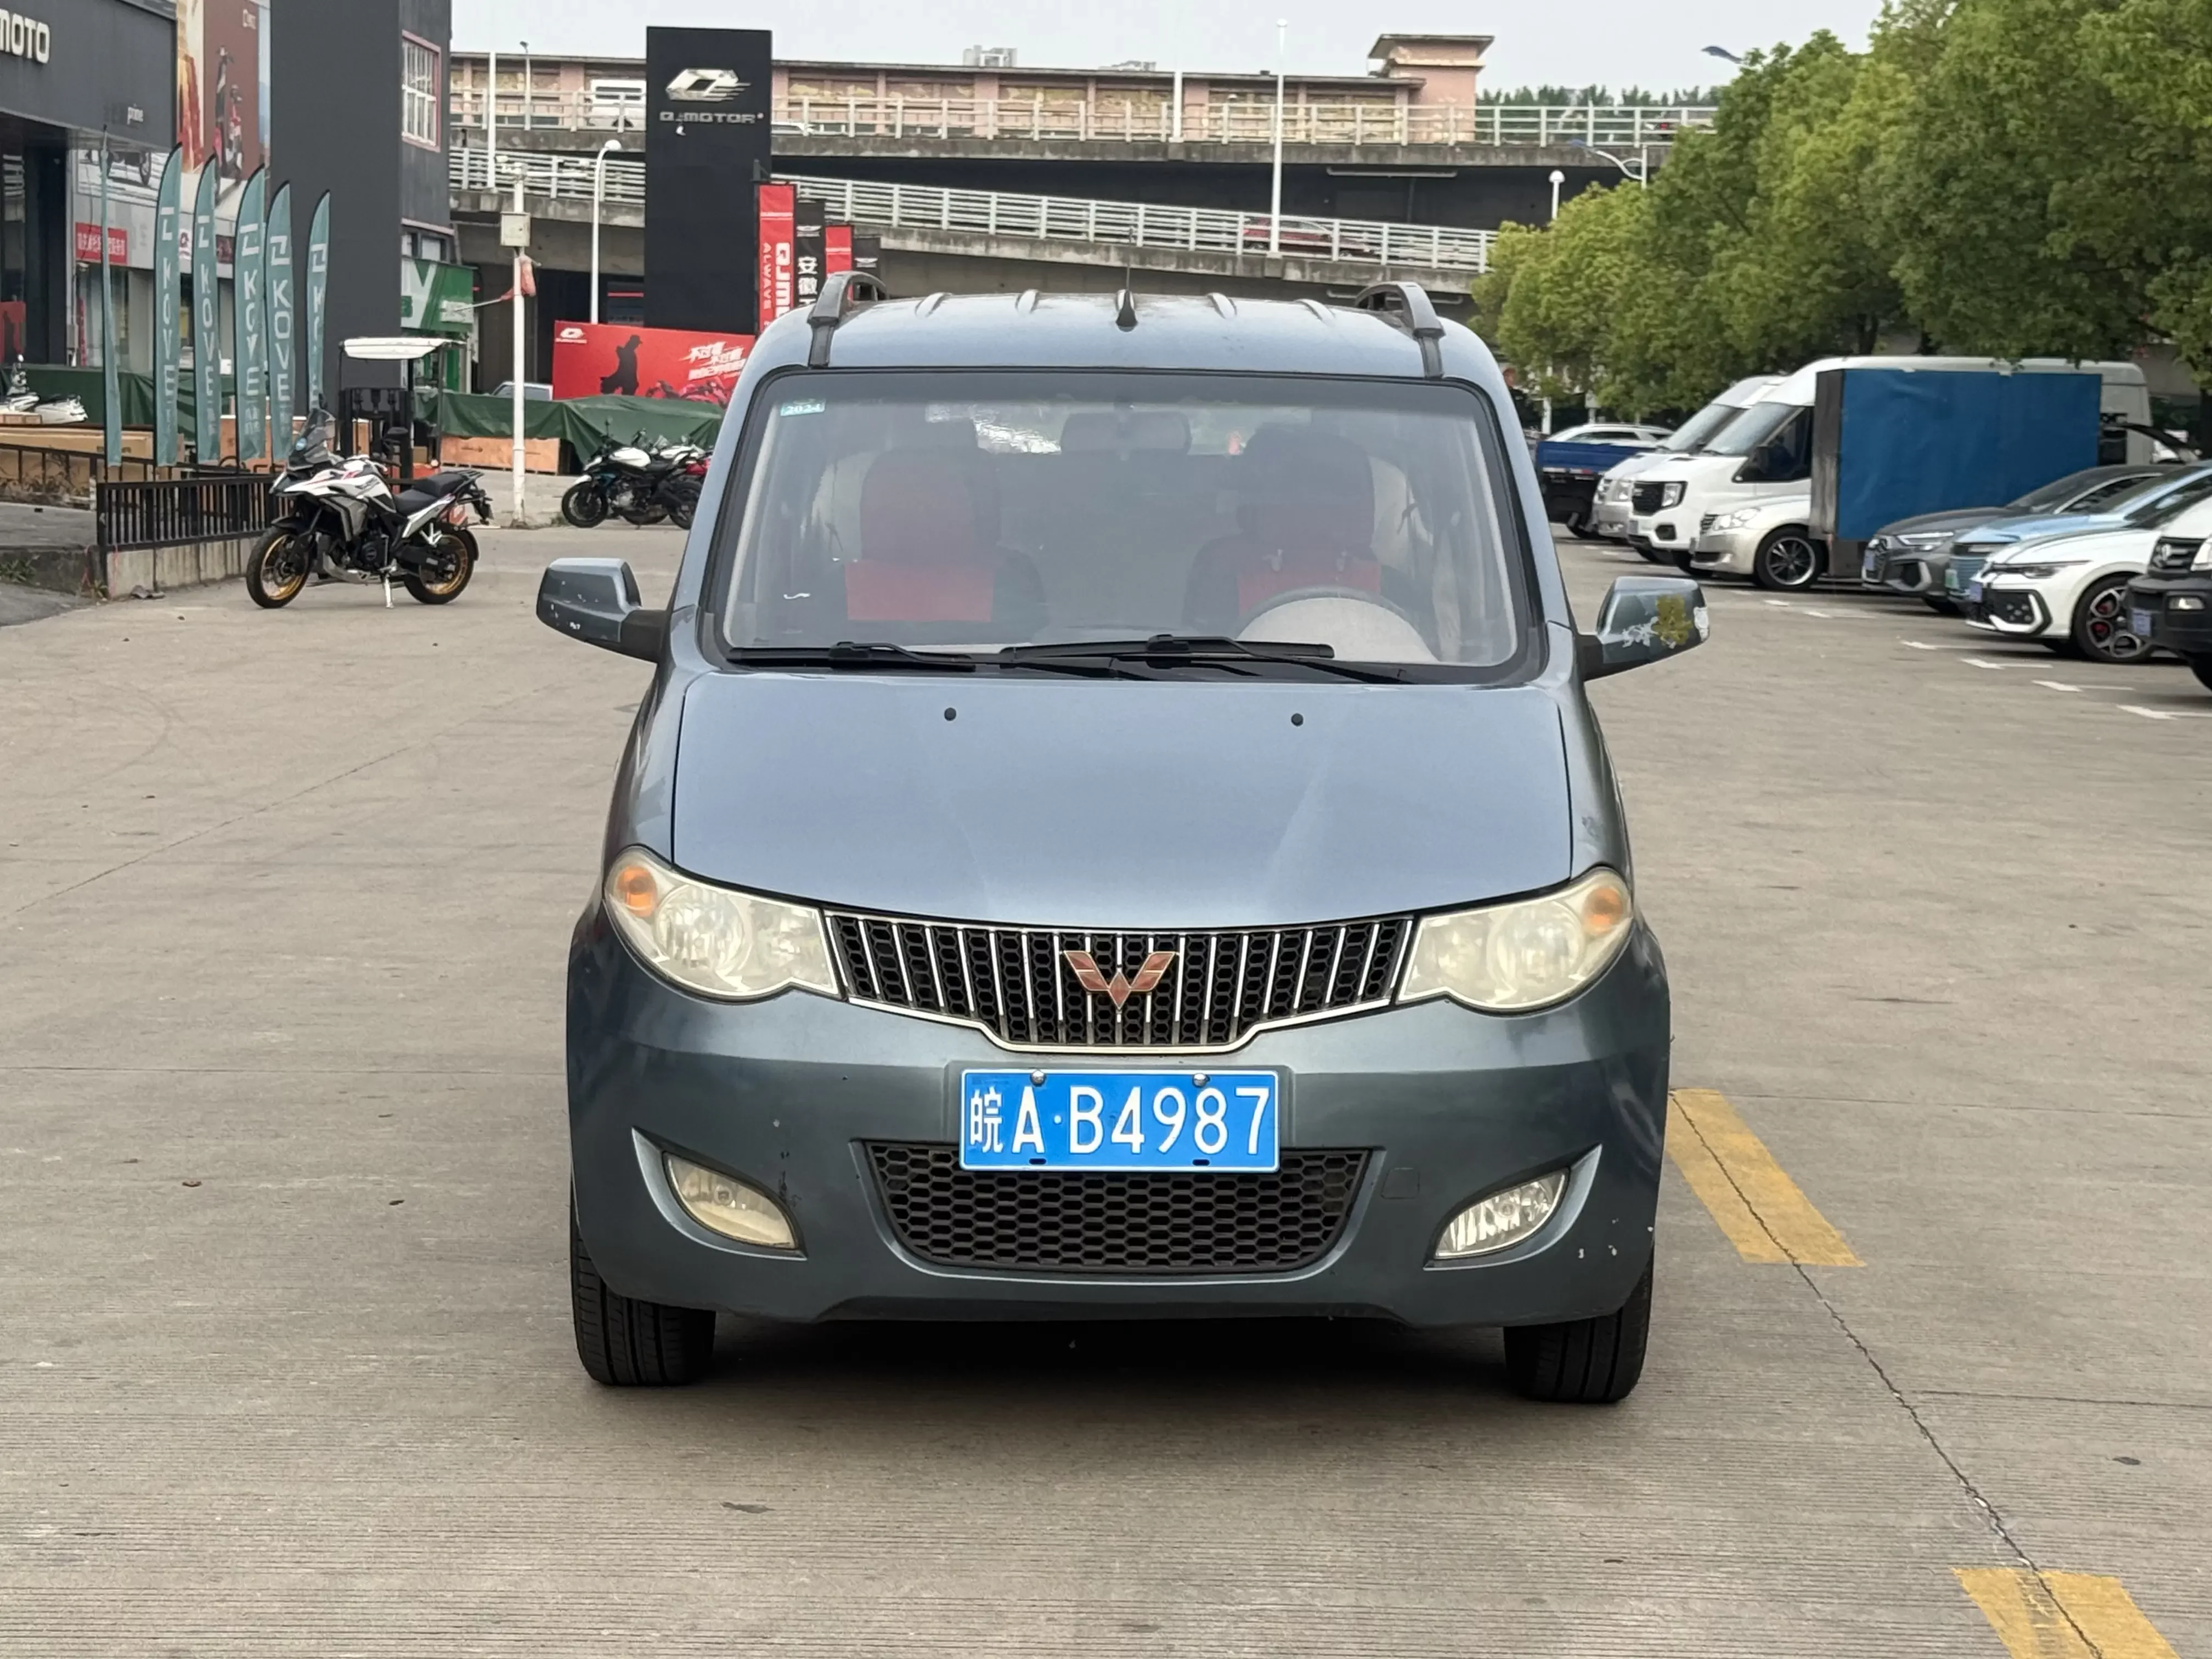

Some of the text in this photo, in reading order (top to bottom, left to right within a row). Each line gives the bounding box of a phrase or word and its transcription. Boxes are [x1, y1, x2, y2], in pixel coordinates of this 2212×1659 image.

[200, 264, 215, 396] KOVE
[273, 279, 292, 401] KOVE
[969, 1086, 1269, 1155] 皖A·B4987
